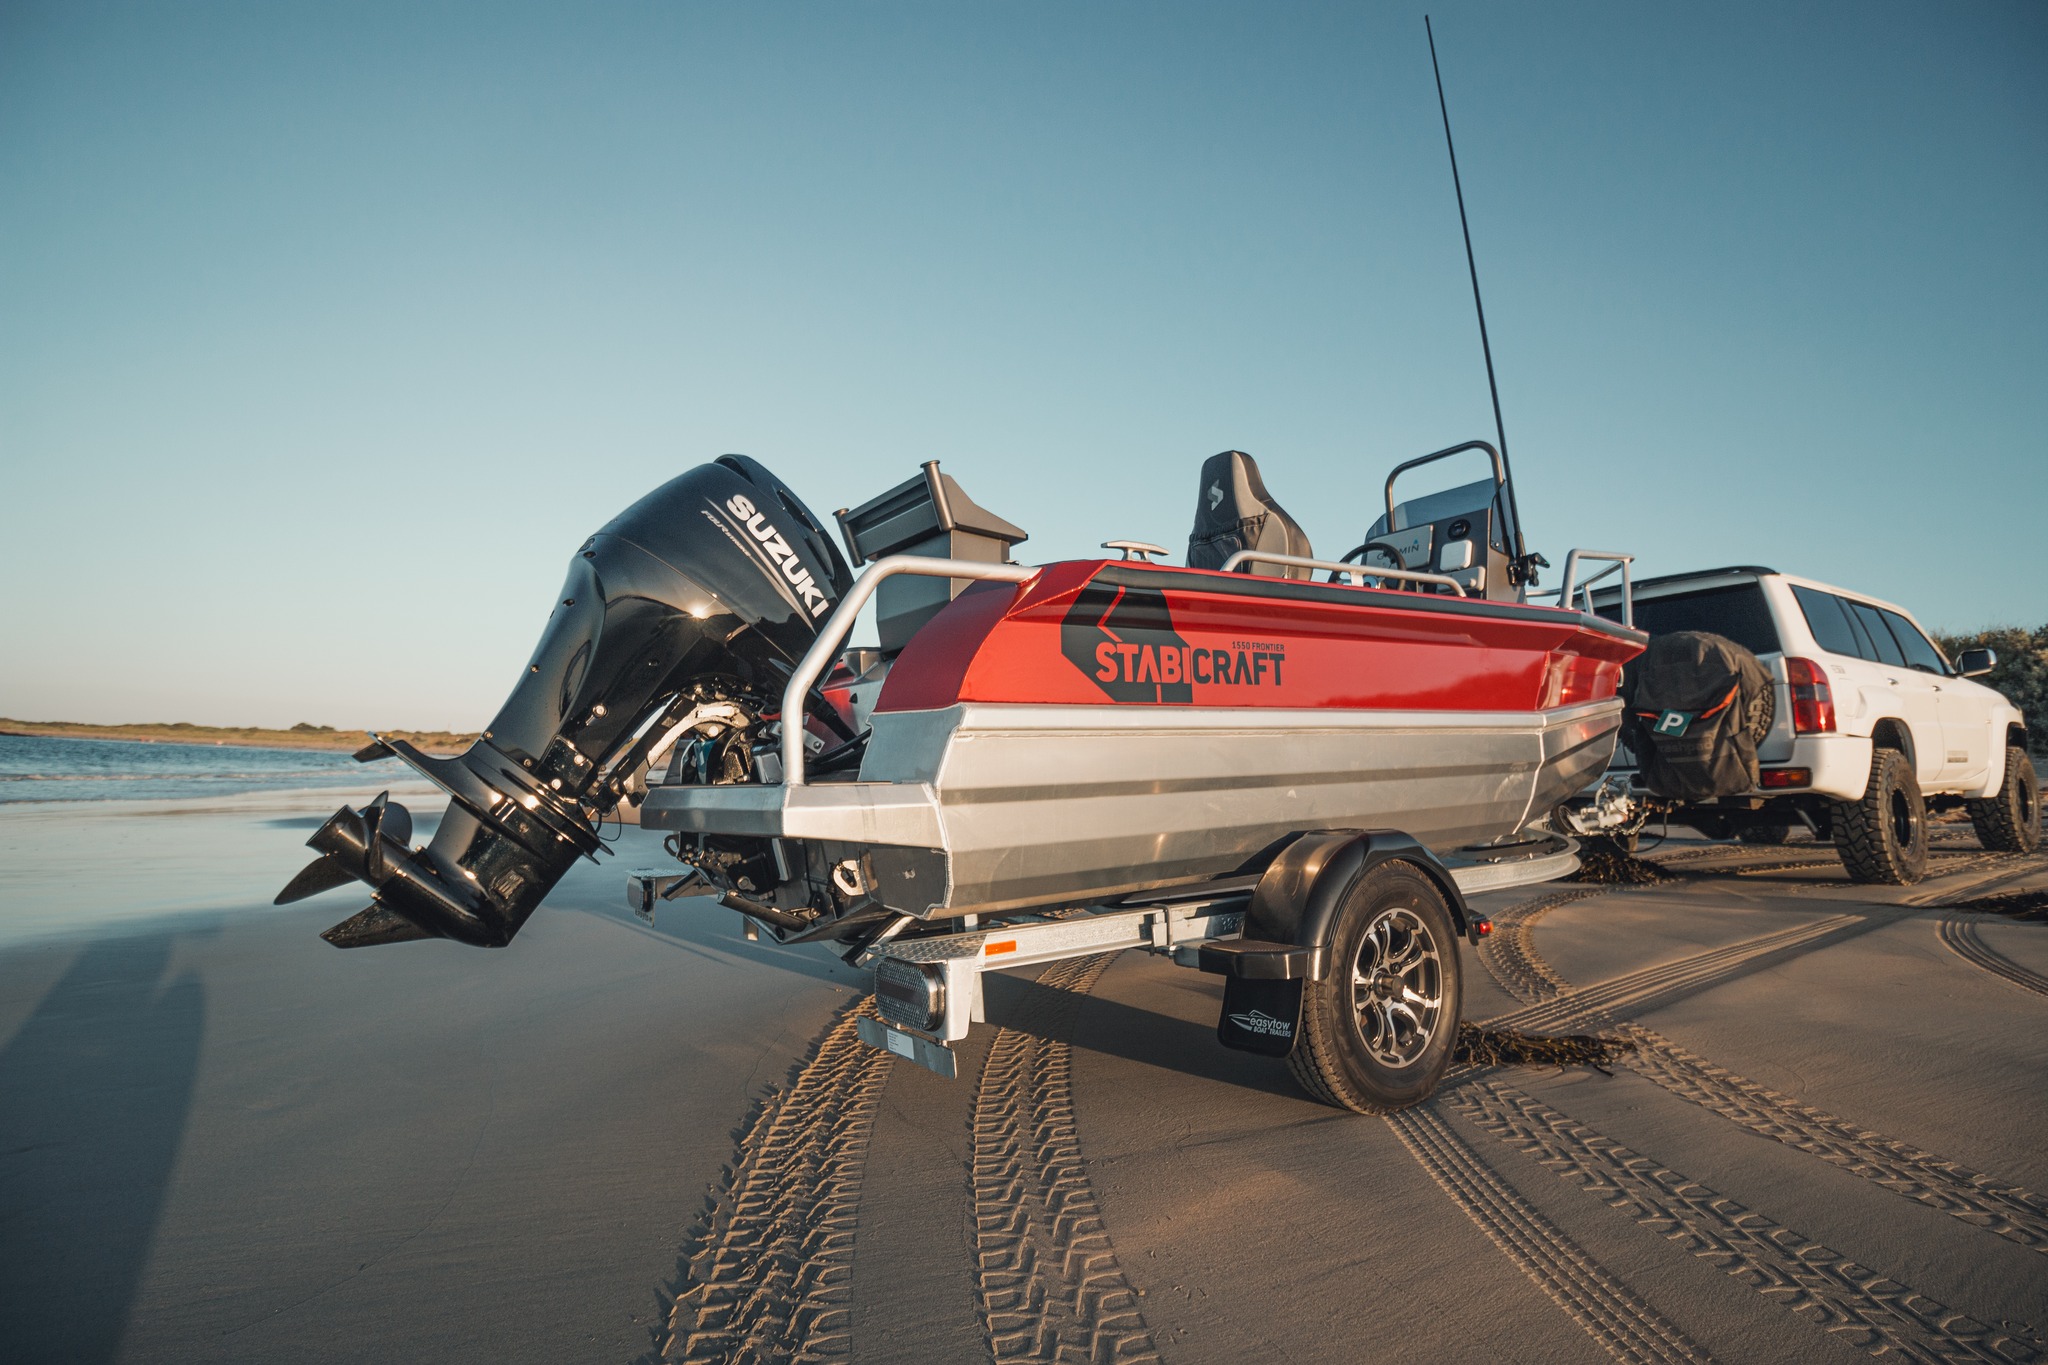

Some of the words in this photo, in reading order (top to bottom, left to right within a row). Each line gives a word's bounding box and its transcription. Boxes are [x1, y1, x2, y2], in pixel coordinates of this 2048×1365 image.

[726, 494, 829, 618] SUZUKI
[1377, 544, 1419, 560] GMIN
[1232, 641, 1251, 650] 1550
[1252, 642, 1285, 652] FRONTIER
[1096, 641, 1285, 686] STABICRAFT
[1660, 713, 1684, 731] P
[1250, 1017, 1290, 1030] easytow
[1269, 1028, 1291, 1037] TRAILERS
